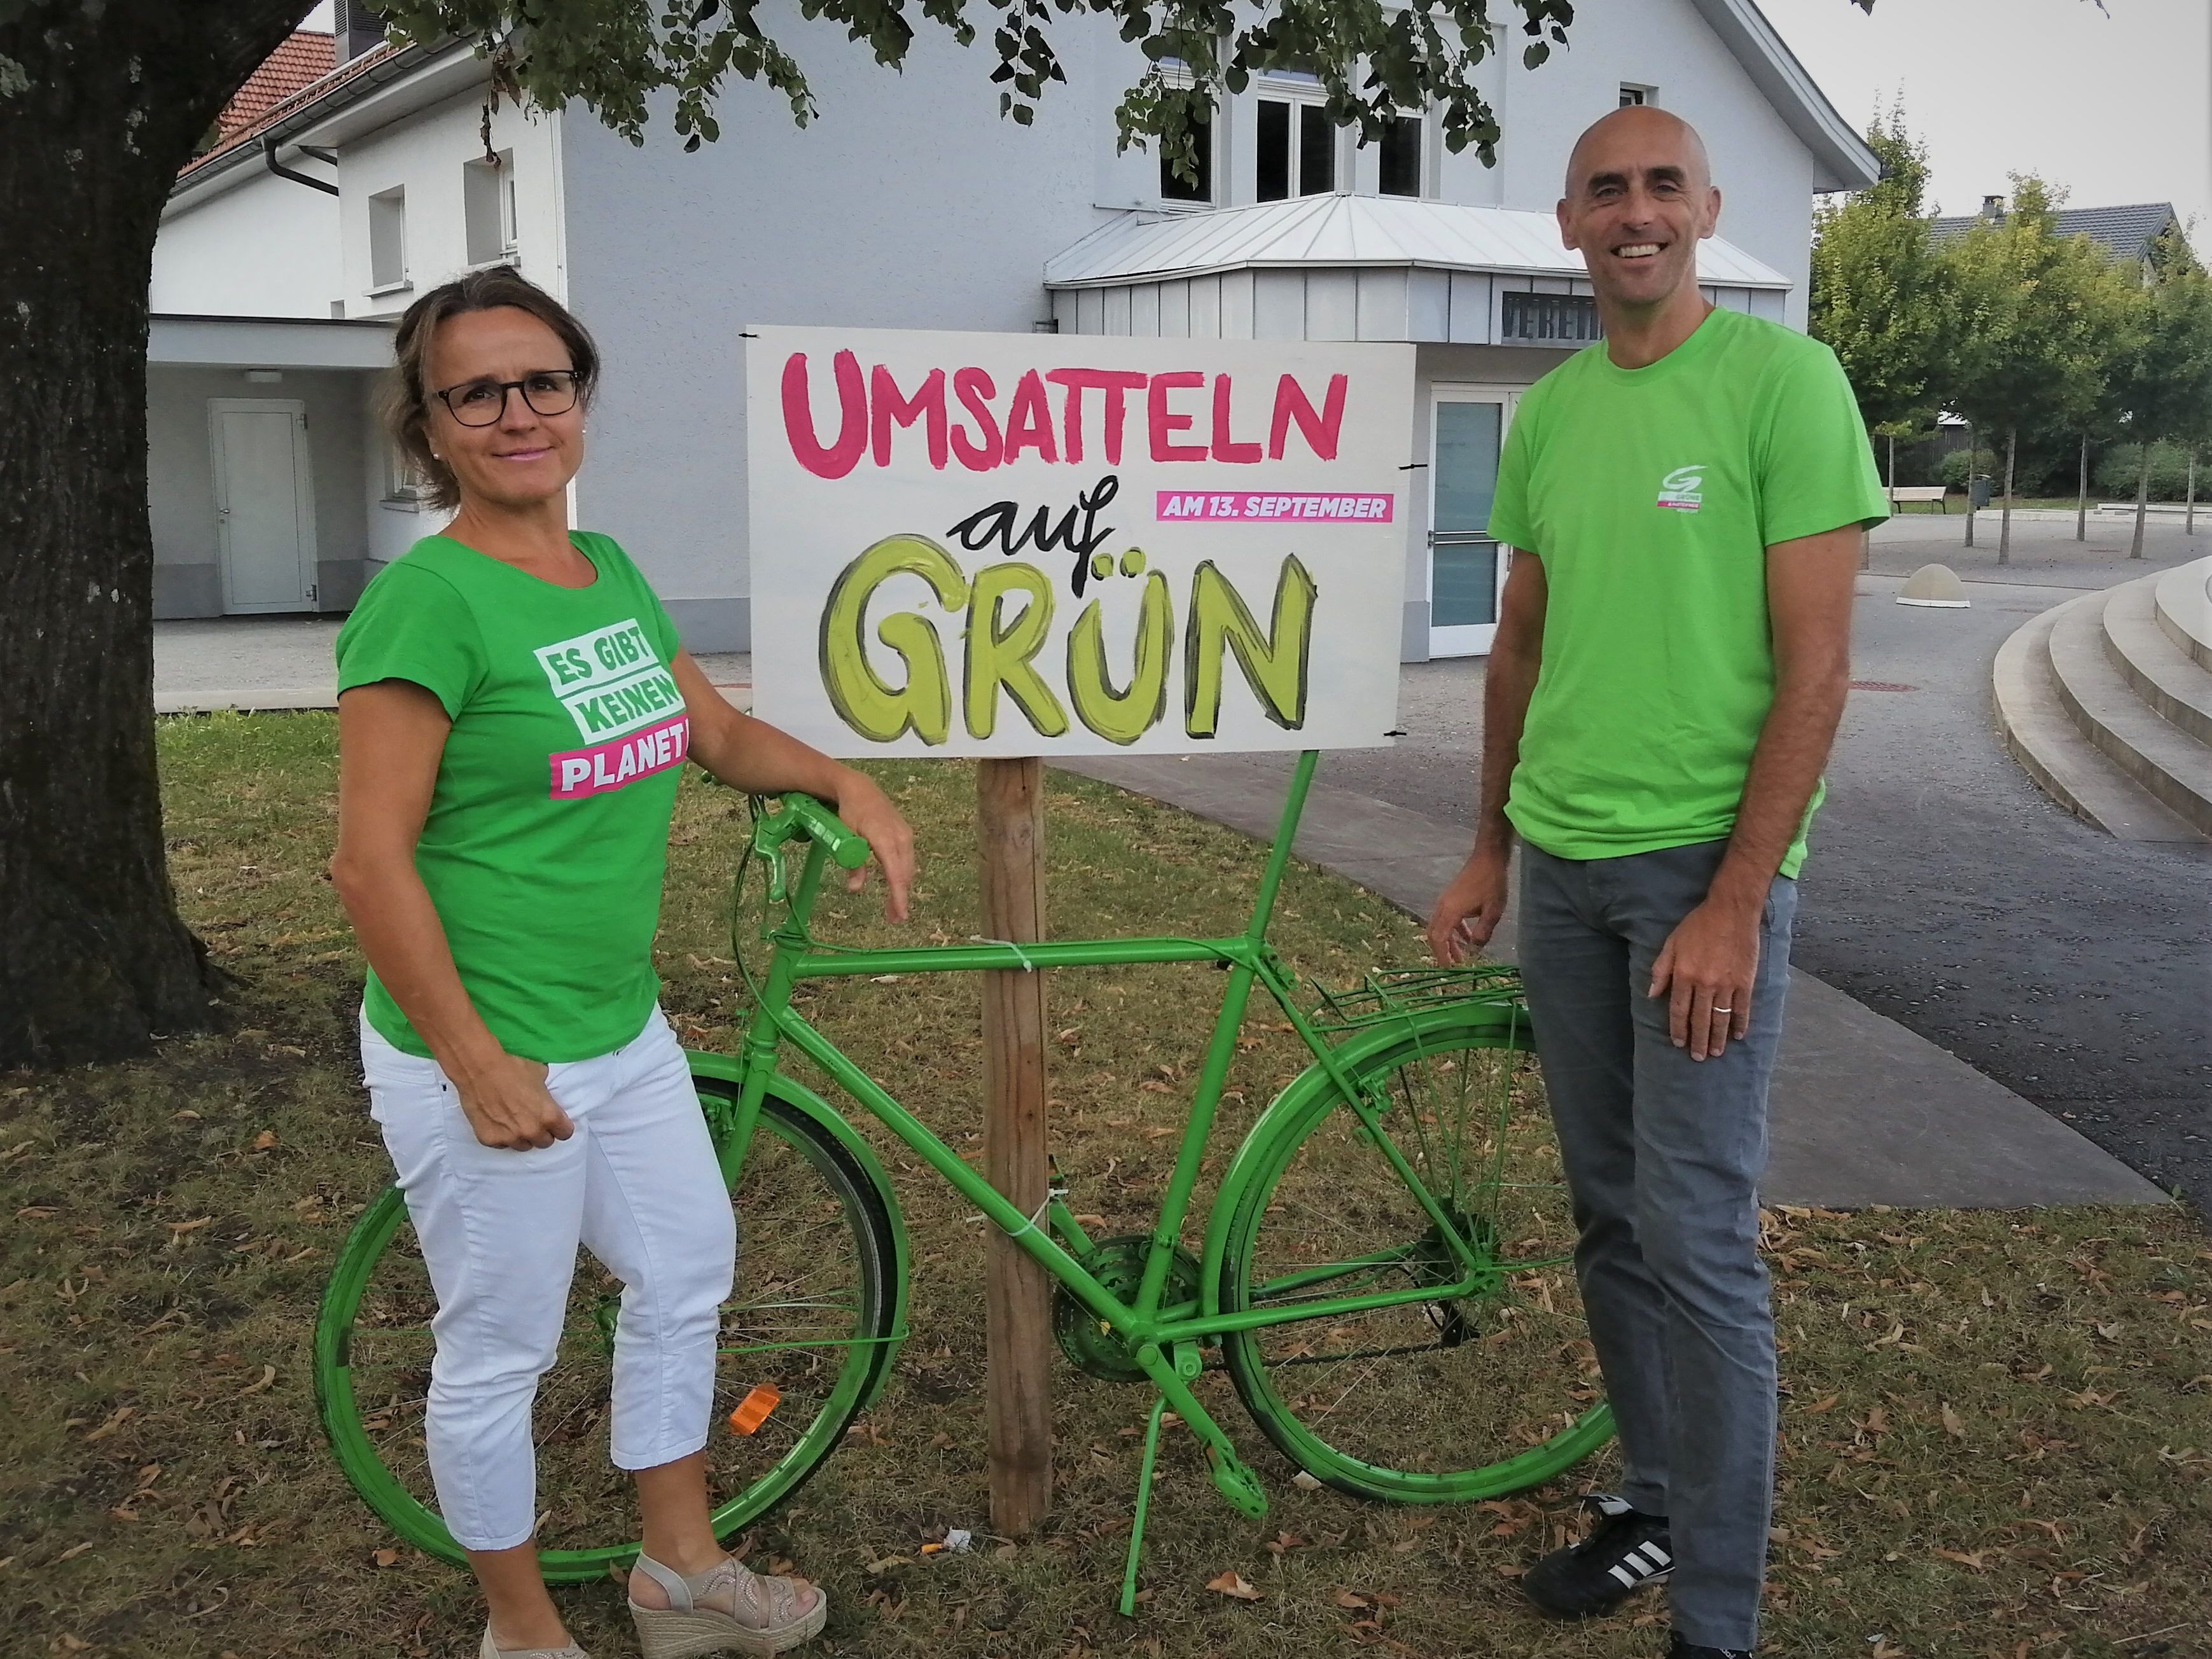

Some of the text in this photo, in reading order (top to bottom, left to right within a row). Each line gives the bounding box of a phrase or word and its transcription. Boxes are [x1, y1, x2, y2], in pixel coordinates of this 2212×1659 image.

[781, 349, 1347, 479] UMSATTELN
[946, 475, 1118, 598] auf
[1162, 496, 1388, 519] AM 13. SEPTEMBER
[545, 626, 650, 686] ES GIBT
[819, 533, 1318, 746] GRÜN
[574, 673, 680, 733] KEINEN
[560, 722, 685, 792] PLANET
